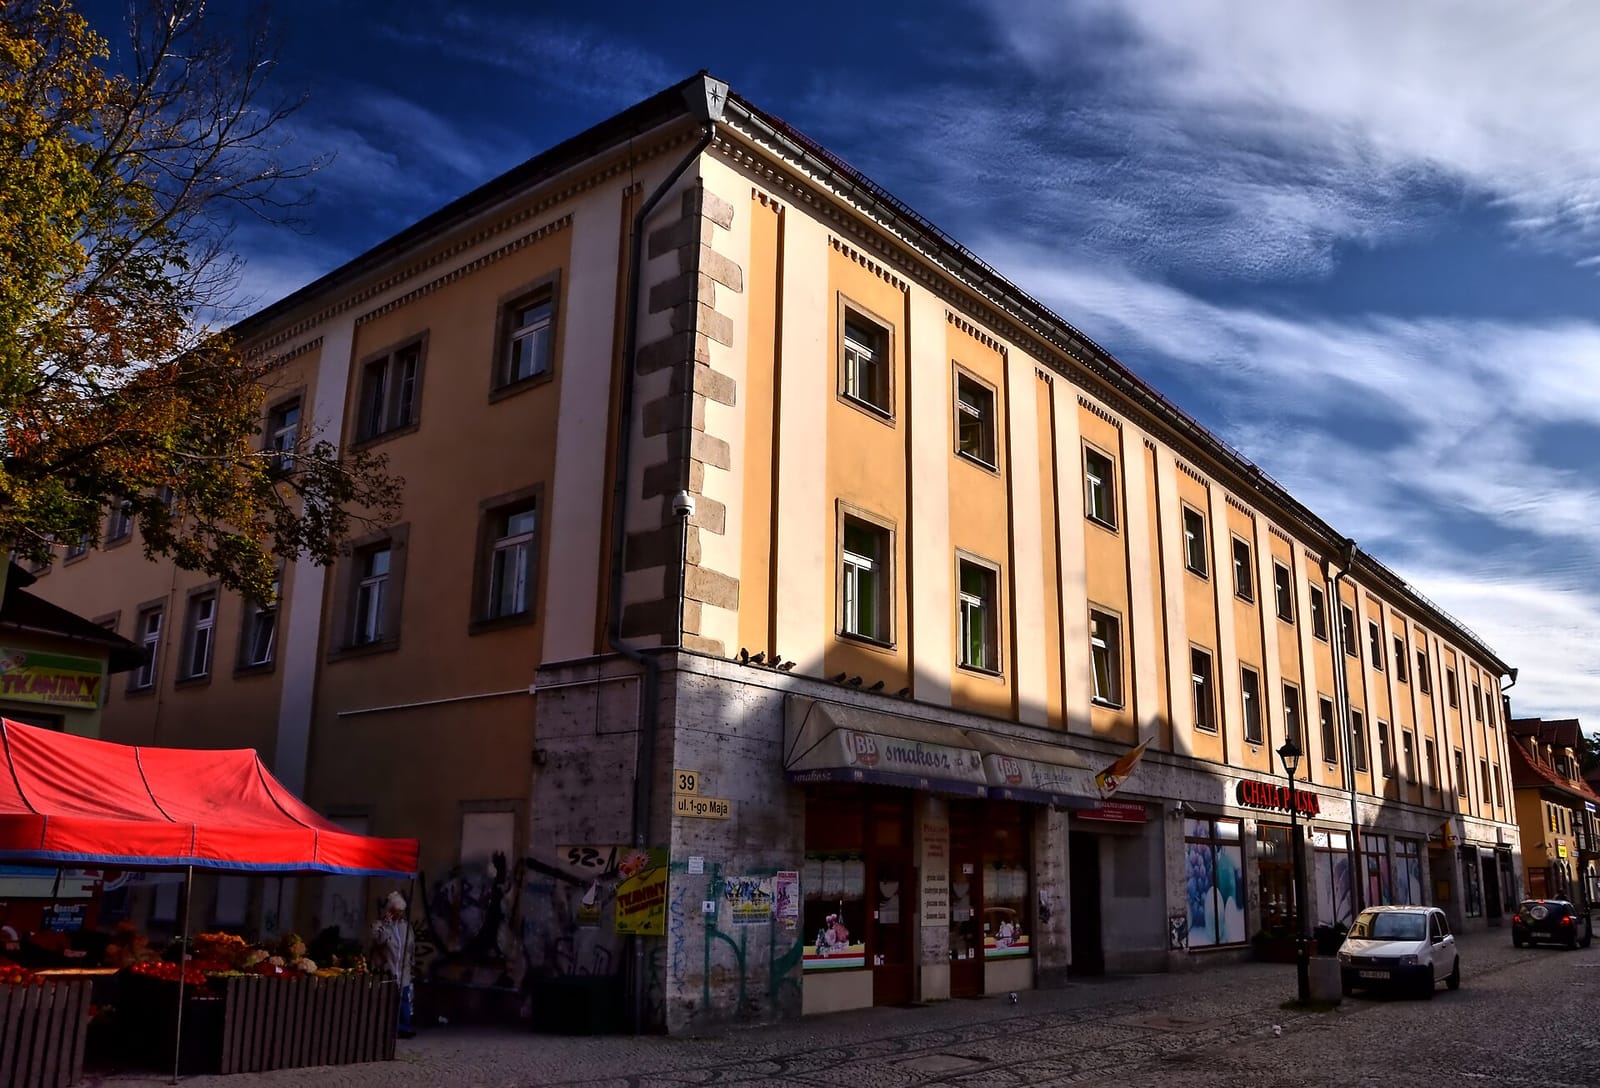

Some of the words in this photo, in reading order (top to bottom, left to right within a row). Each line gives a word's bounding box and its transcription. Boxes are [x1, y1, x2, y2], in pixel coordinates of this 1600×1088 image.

[3, 674, 99, 695] TKANINY
[885, 743, 951, 769] smakosz
[678, 774, 695, 791] 39
[1241, 779, 1281, 807] CHATA
[709, 801, 728, 816] Maja
